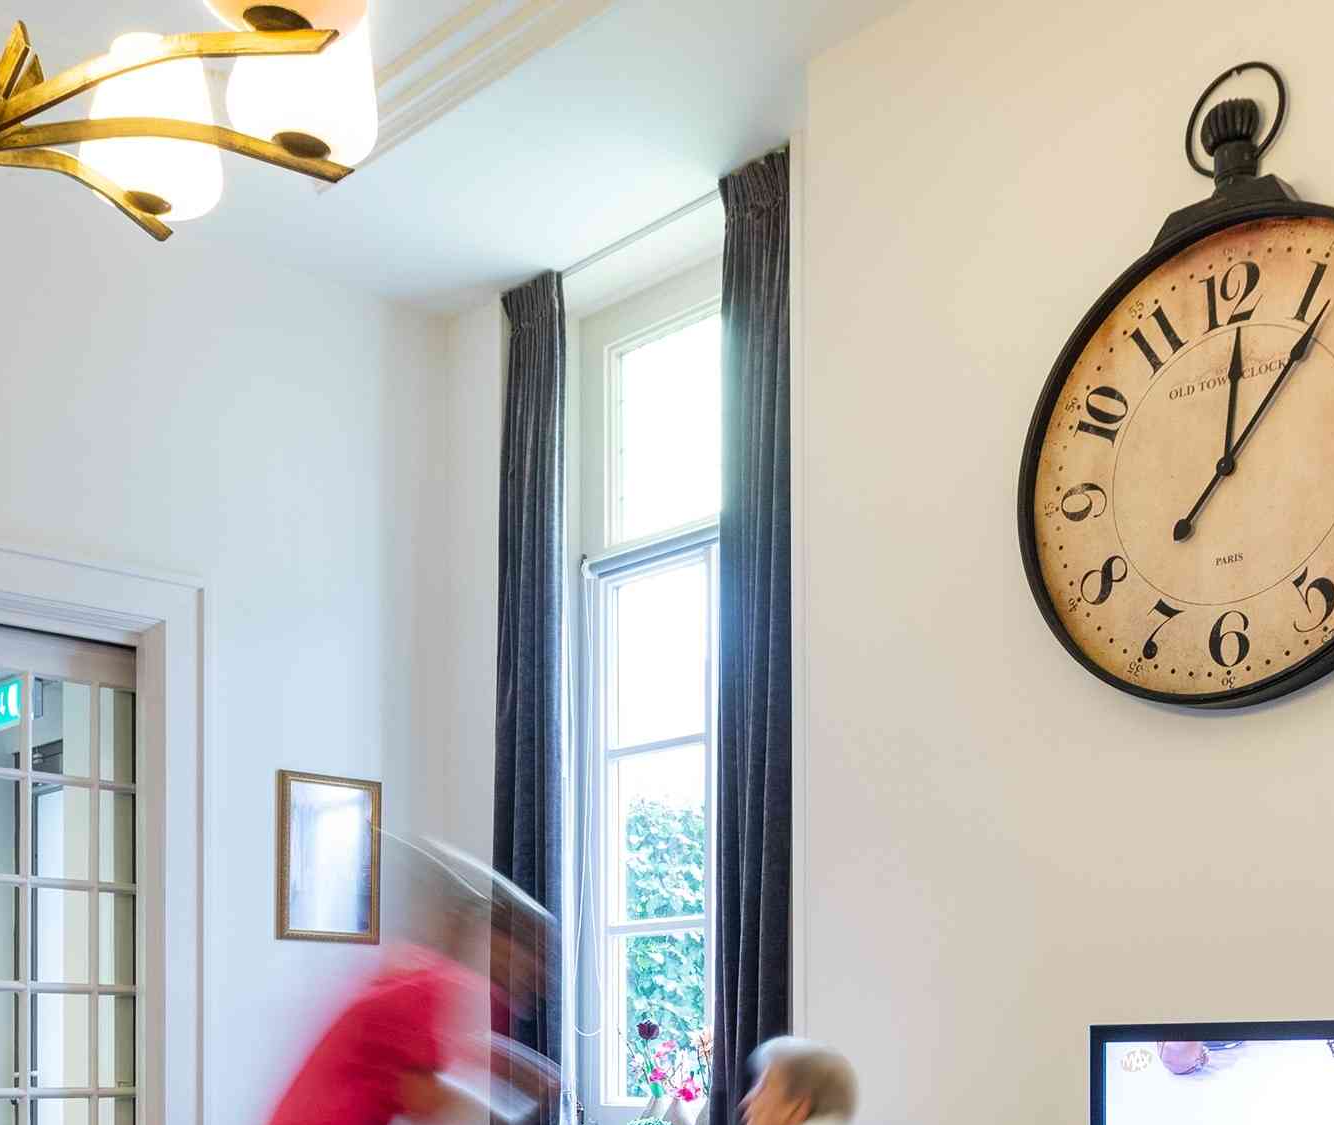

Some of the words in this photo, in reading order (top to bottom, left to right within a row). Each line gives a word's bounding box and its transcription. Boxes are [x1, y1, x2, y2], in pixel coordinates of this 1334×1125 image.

[1129, 299, 1145, 319] 55
[1198, 260, 1264, 335] 12
[1285, 260, 1328, 322] 1
[1125, 305, 1189, 380] 11
[1074, 386, 1129, 447] 10
[1169, 384, 1196, 401] OLD
[1061, 482, 1107, 522] 9
[1080, 555, 1128, 606] 8
[1215, 553, 1244, 567] PARIS
[1142, 598, 1186, 660] 7
[1208, 610, 1250, 668] 6
